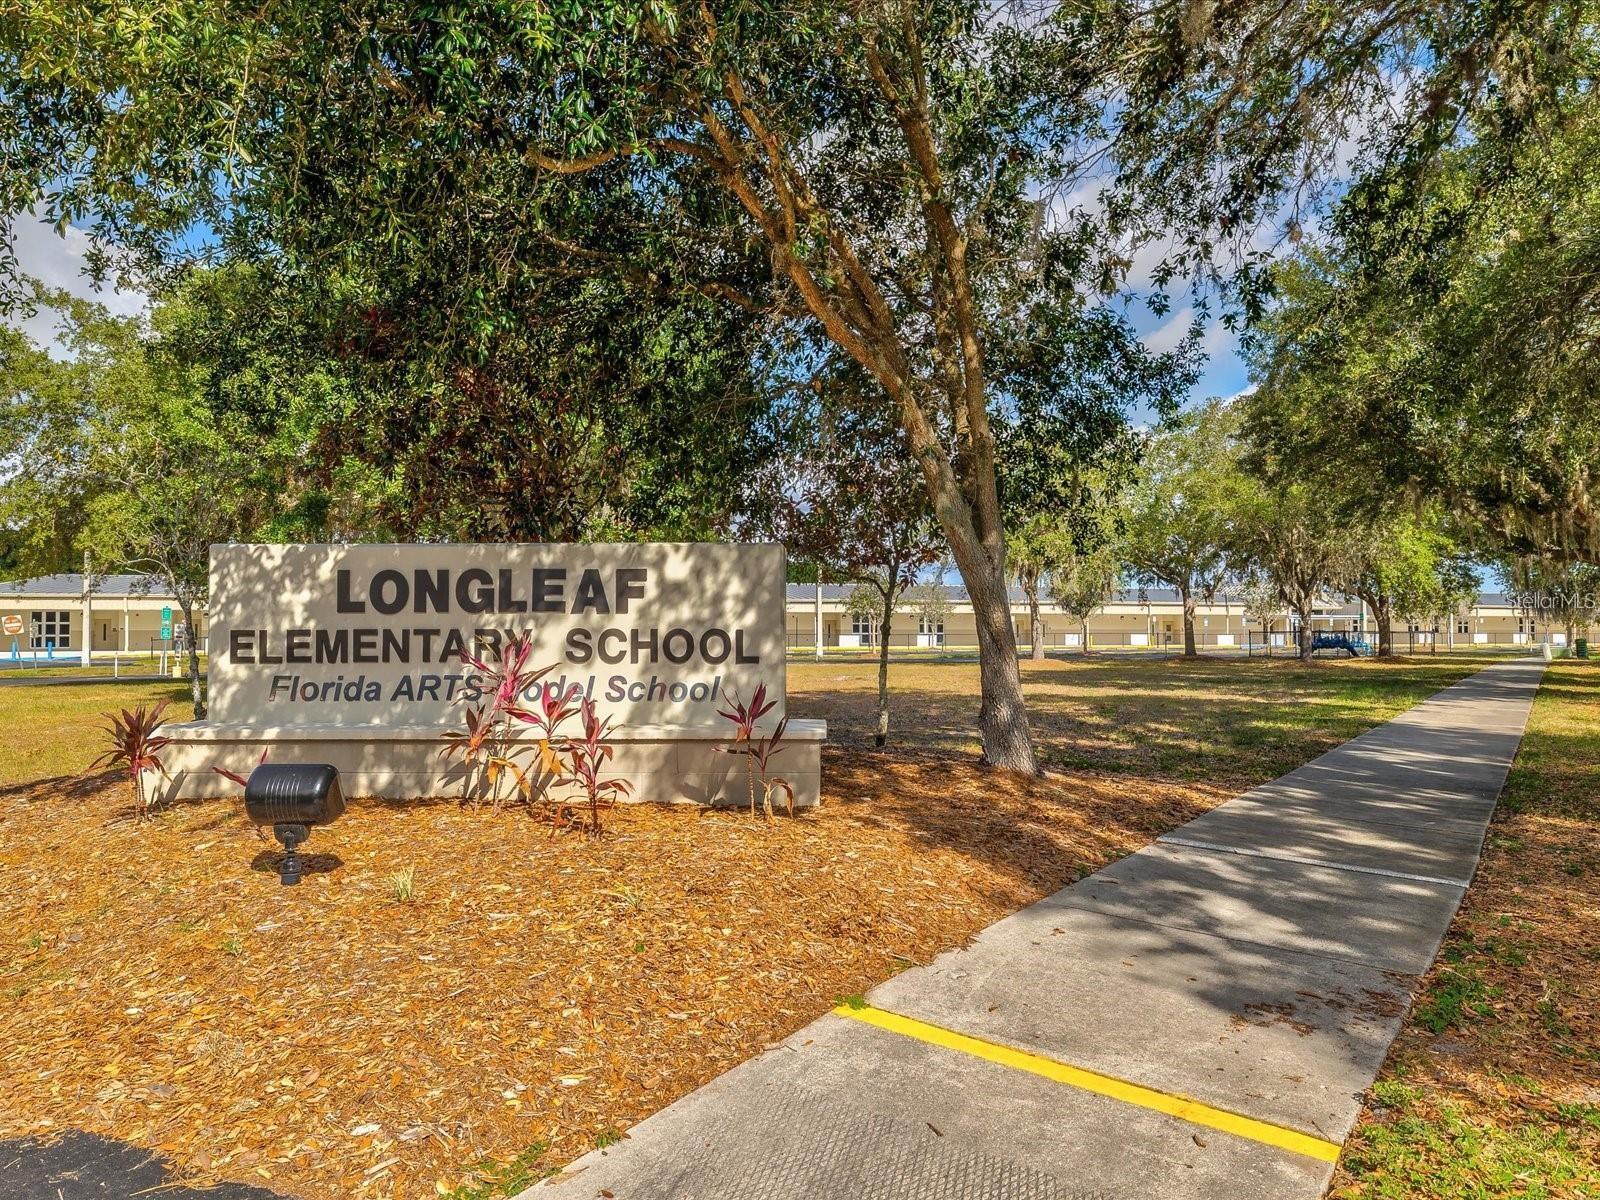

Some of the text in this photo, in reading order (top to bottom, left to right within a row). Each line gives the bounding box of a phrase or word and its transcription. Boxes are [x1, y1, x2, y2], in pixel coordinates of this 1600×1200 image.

[336, 568, 647, 615] LONGLEAF
[229, 628, 533, 665] ELEMENTARY
[565, 628, 761, 665] SCHOOL
[269, 674, 720, 702] Florida ARTS odel School
